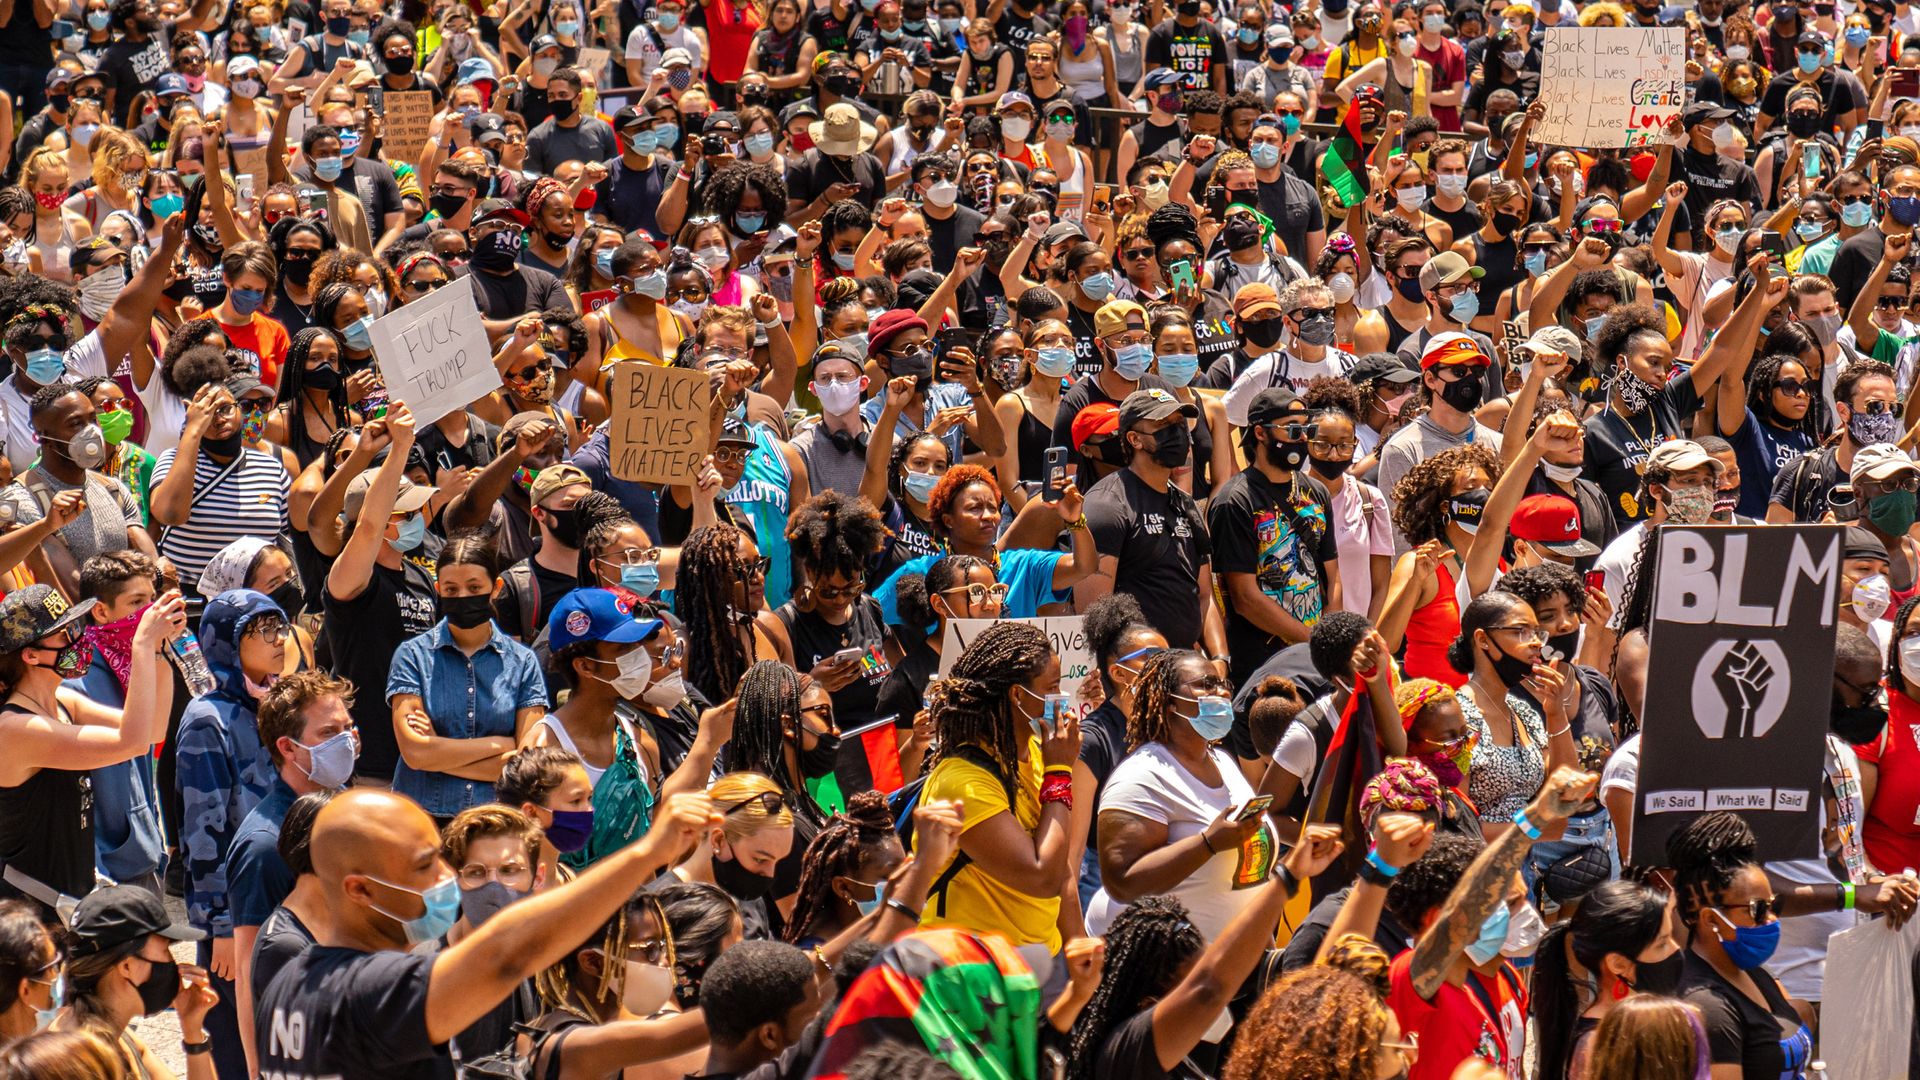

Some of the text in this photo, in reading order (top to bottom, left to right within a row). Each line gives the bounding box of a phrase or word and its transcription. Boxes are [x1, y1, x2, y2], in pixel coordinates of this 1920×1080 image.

[1544, 28, 1586, 55] Black
[1594, 28, 1630, 55] Lives
[1543, 54, 1586, 79] Black
[1594, 55, 1627, 80] Lives
[1542, 78, 1682, 106] Black Lives Create
[1586, 104, 1622, 128] Lives
[1532, 123, 1568, 145] Black
[1582, 128, 1614, 148] Lives
[496, 230, 521, 250] NO
[194, 282, 219, 294] END
[401, 304, 462, 365] FUCK
[408, 349, 467, 399] TRUMP
[630, 372, 704, 412] BLACK
[625, 416, 698, 446] LIVES
[616, 448, 700, 478] MATTER
[1655, 530, 1840, 627] BLM
[1652, 792, 1802, 808] We Said What We Said
[270, 1007, 305, 1060] NO
